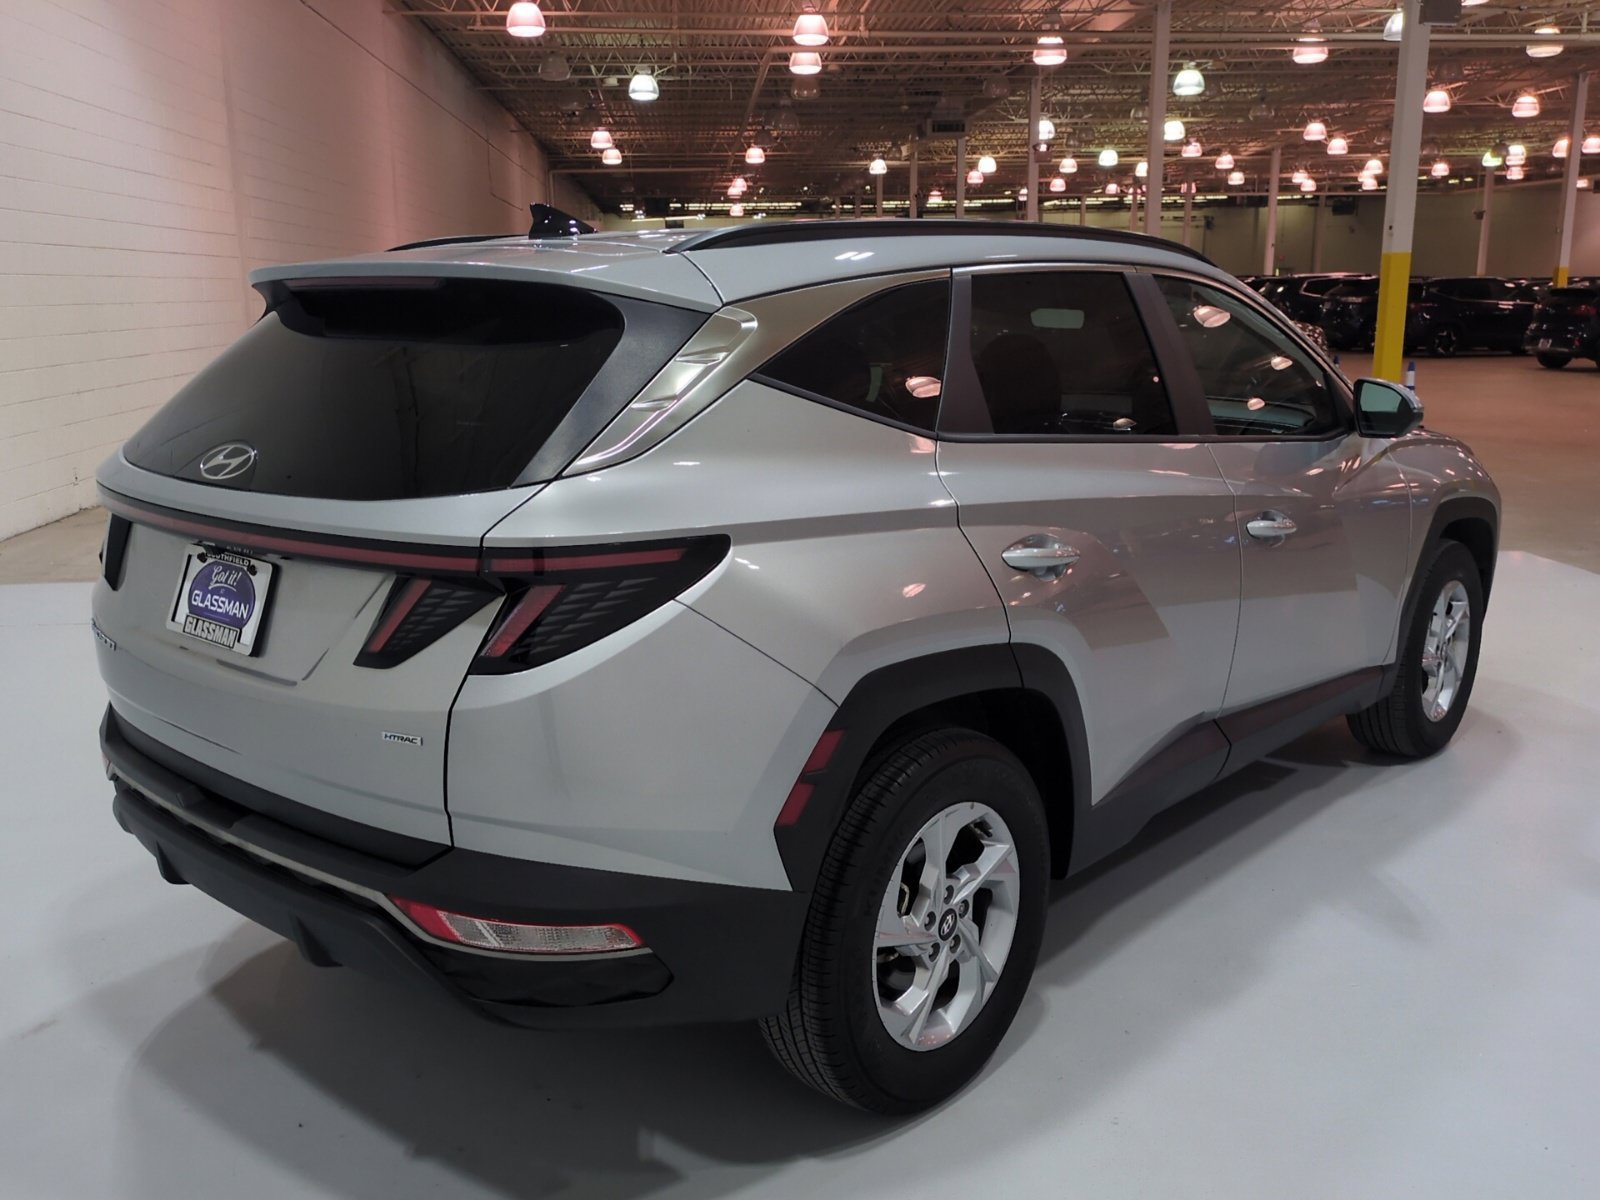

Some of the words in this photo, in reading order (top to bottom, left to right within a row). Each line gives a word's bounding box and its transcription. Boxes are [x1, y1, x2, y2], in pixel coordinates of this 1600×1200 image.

[210, 565, 229, 586] Got
[228, 571, 242, 586] it!
[191, 590, 249, 619] GLASSMAN
[184, 617, 237, 648] GLASSMAN
[384, 733, 418, 745] HTRAC
